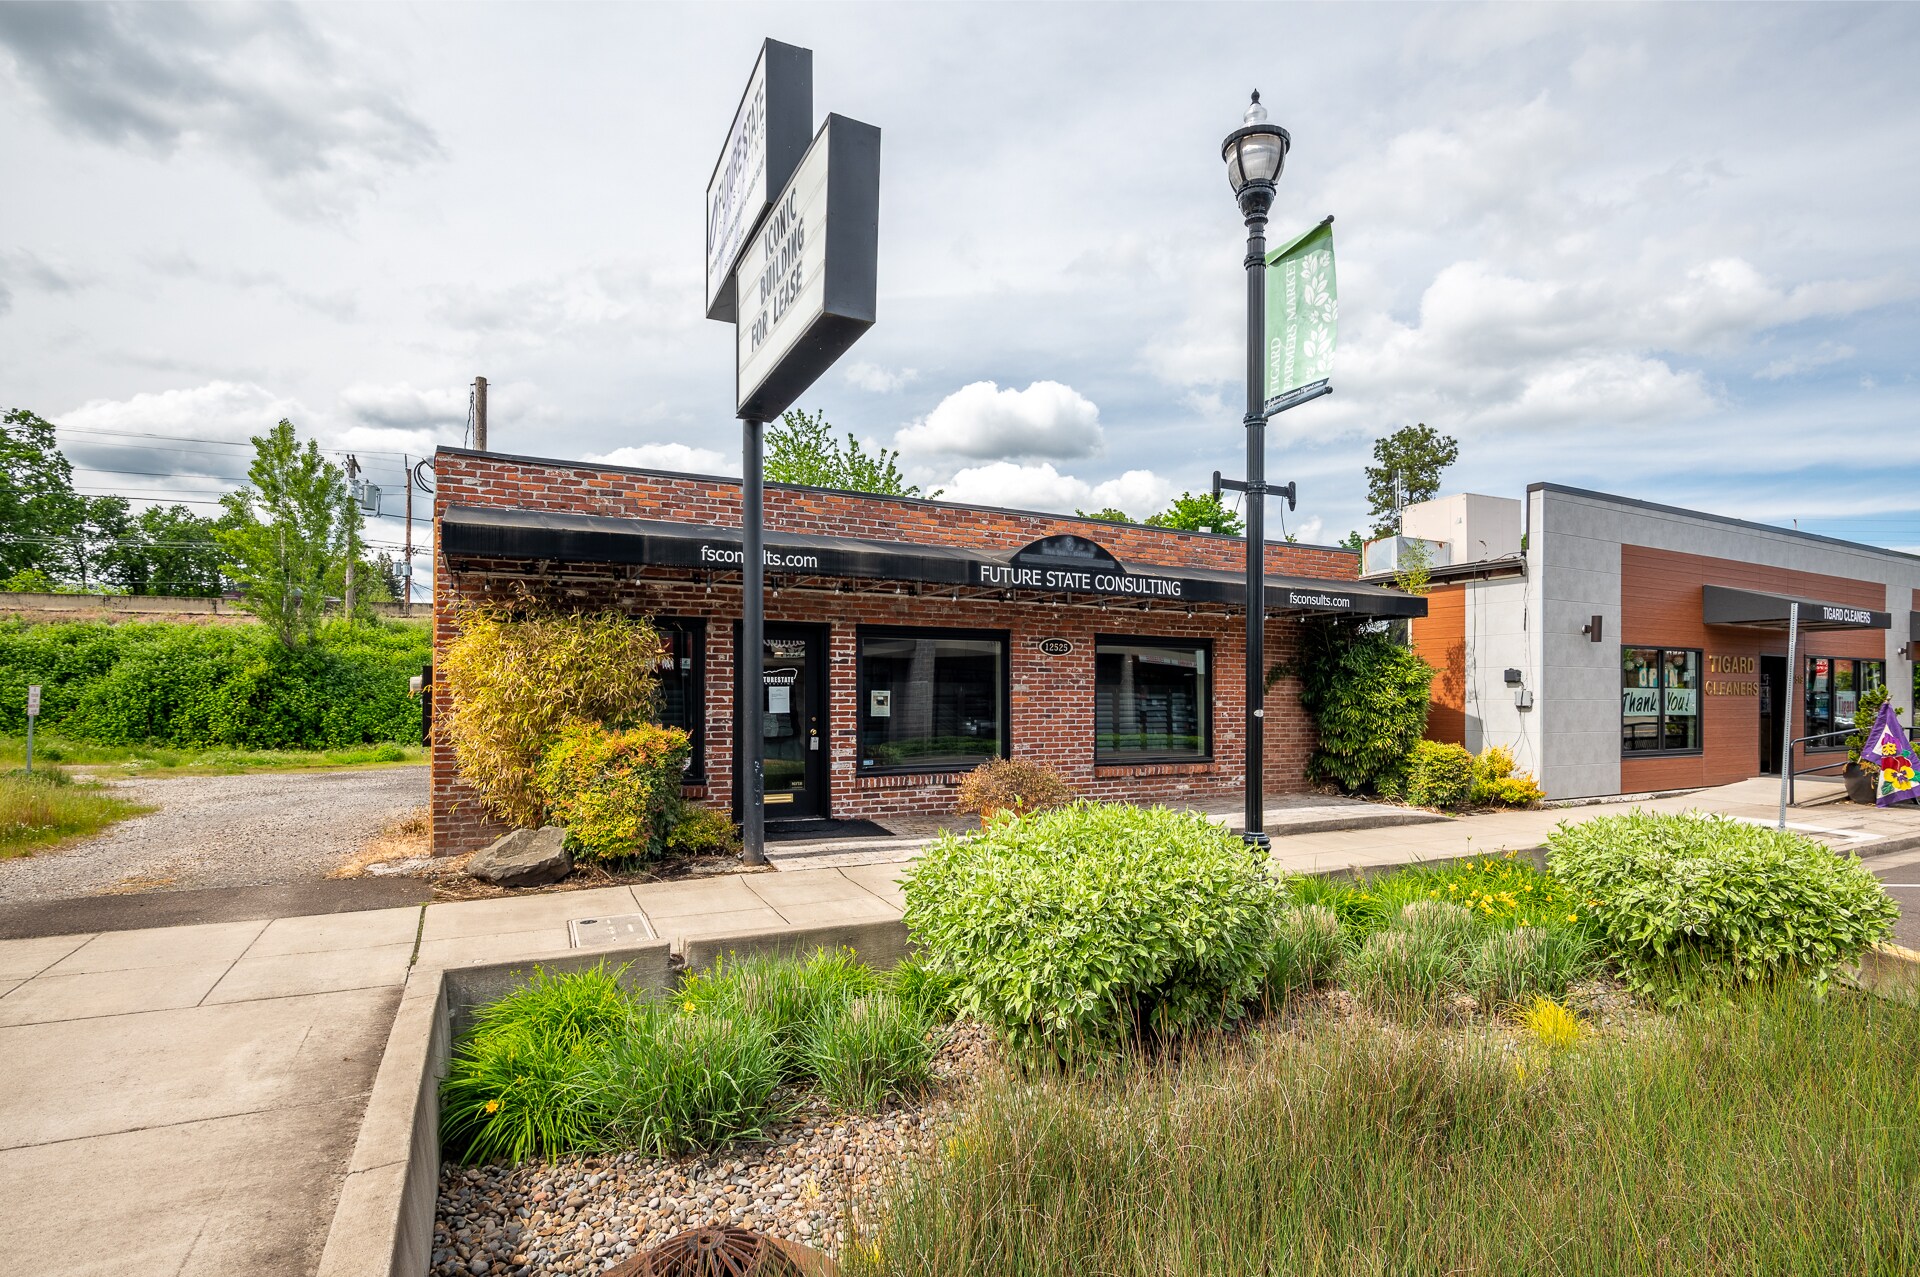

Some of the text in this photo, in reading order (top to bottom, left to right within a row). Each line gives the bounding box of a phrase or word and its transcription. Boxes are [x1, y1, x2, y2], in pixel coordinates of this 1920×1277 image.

[719, 134, 742, 219] FUTURE
[743, 78, 764, 161] STATE
[764, 187, 797, 262] ICONIC
[760, 216, 805, 307] BUILDING
[751, 261, 803, 353] FOR LEASE
[1283, 258, 1298, 392] FARMERS MARKET
[1270, 337, 1281, 395] TIGARD
[701, 545, 818, 568] fsconlts.com
[980, 565, 1181, 596] FUTURE STATE CONSULTING
[1289, 592, 1350, 608] fsconsults.com
[1823, 606, 1871, 624] TIGARD CLEANERS
[1044, 643, 1069, 652] 12525
[1708, 655, 1755, 674] TIGARD
[1623, 691, 1690, 713] Thank You!
[1705, 680, 1759, 697] CLEANERS
